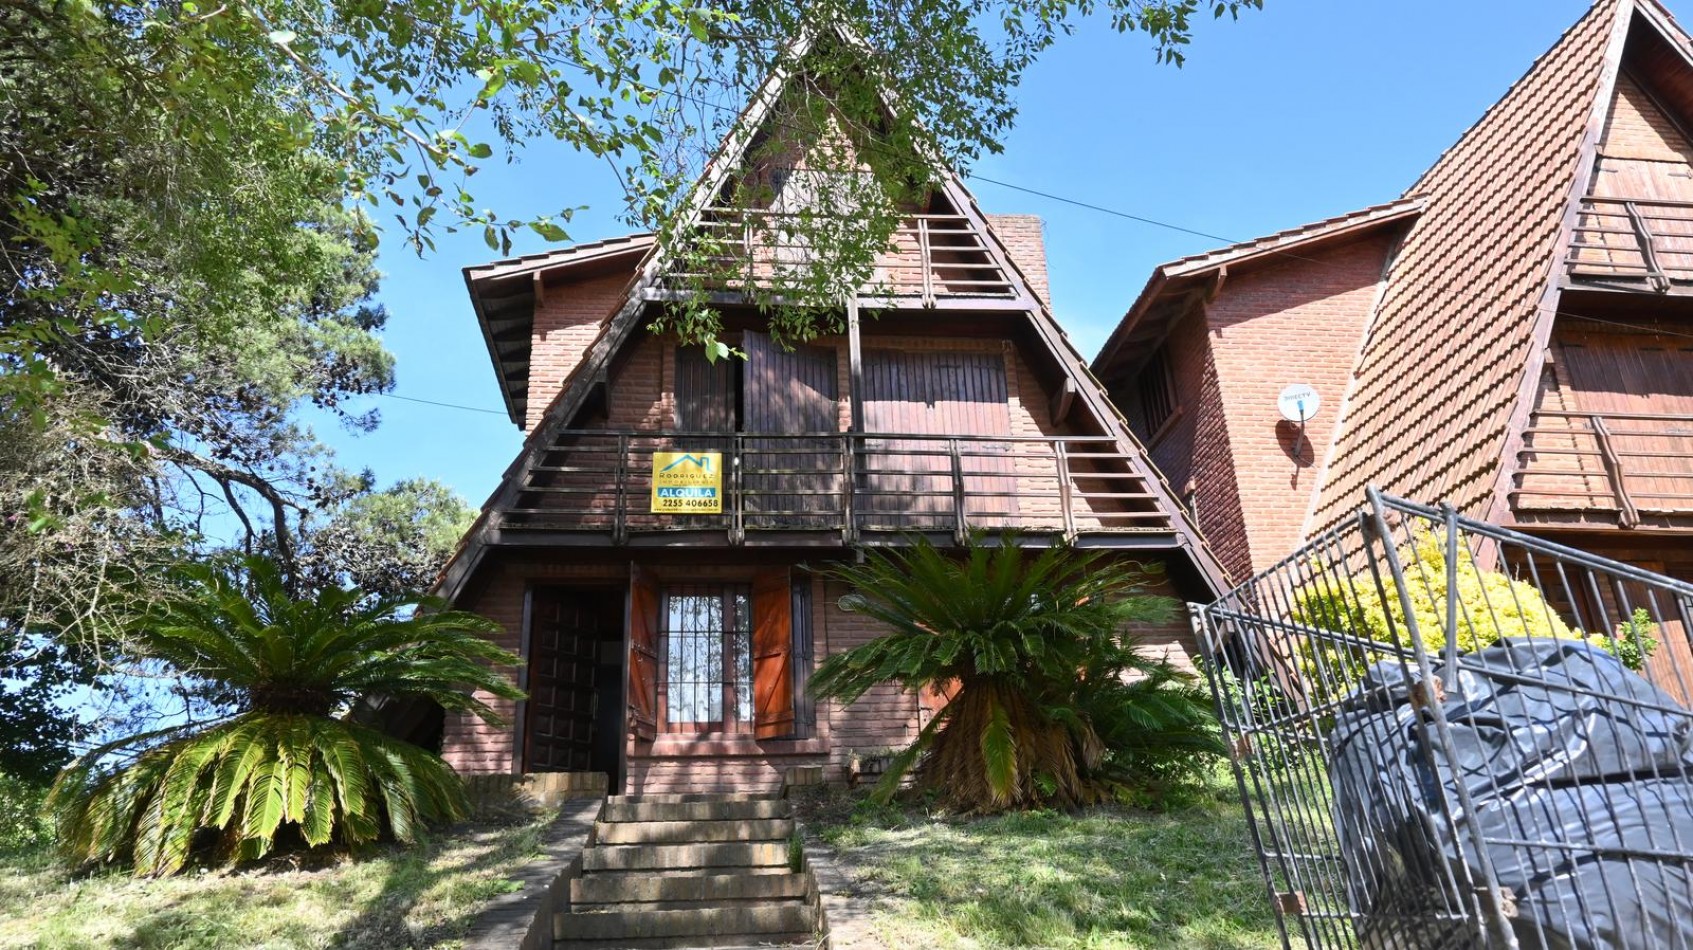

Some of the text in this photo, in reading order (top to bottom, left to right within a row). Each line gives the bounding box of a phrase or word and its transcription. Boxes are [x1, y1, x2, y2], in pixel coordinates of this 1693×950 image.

[660, 488, 713, 497] ALQUILA
[662, 499, 718, 507] 2255 406658
